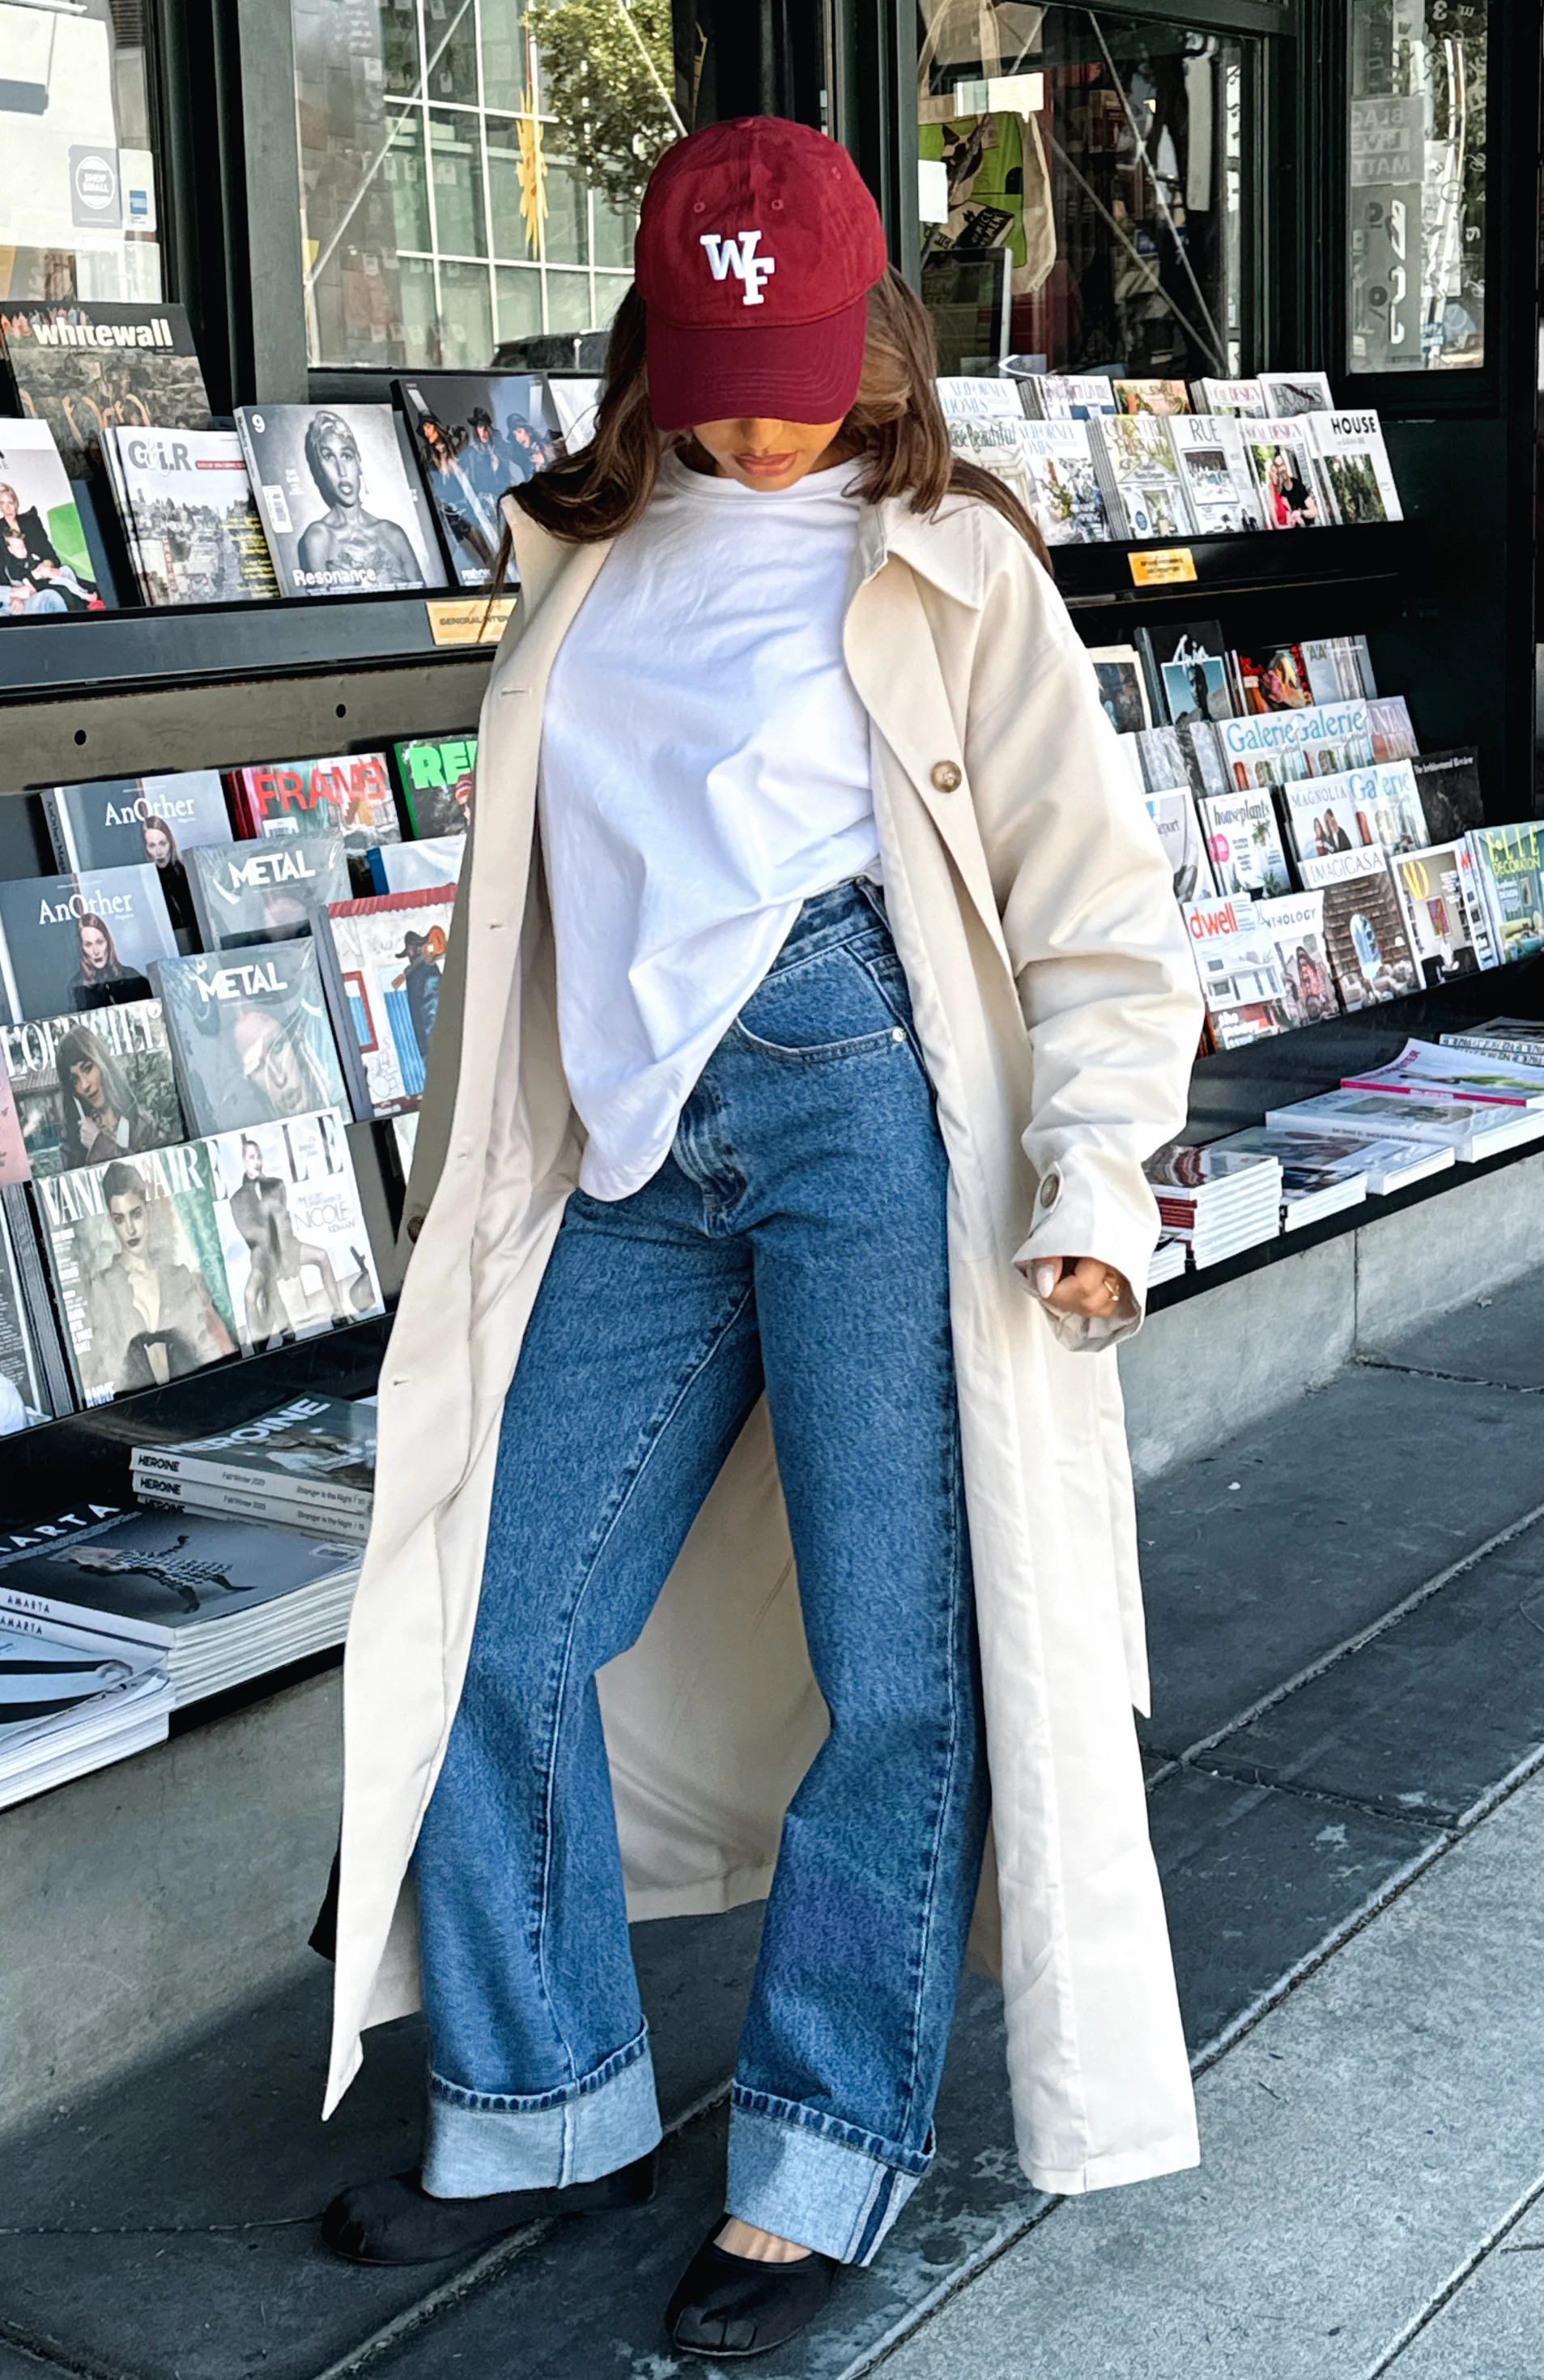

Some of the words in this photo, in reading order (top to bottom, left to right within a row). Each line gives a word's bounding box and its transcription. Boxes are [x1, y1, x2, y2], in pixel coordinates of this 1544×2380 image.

[83, 172, 107, 183] SHOP
[83, 181, 108, 194] SMALL
[32, 317, 173, 347] whitewall
[252, 414, 266, 433] 9
[1189, 419, 1222, 442] RUE
[1330, 416, 1376, 435] HOUSE
[292, 568, 376, 586] Resonance
[1226, 717, 1296, 752] Galerie
[1296, 705, 1364, 742] Galerie
[253, 759, 387, 817] FRAME
[1291, 785, 1347, 808] MAGNOLIA
[104, 794, 195, 826] AnOther
[1213, 799, 1270, 827] houseplants
[1157, 819, 1181, 837] eport
[1485, 824, 1539, 862] ELLE
[228, 850, 316, 888] METAL
[1310, 851, 1383, 883] IMAGICASA
[39, 888, 134, 925] AnOther
[1189, 900, 1239, 939] dwell
[192, 961, 288, 1003] METAL
[206, 1113, 345, 1203] ELE
[151, 1399, 330, 1454] HEROINE
[138, 1455, 180, 1472] HEROINE
[140, 1478, 181, 1495] HEROINE
